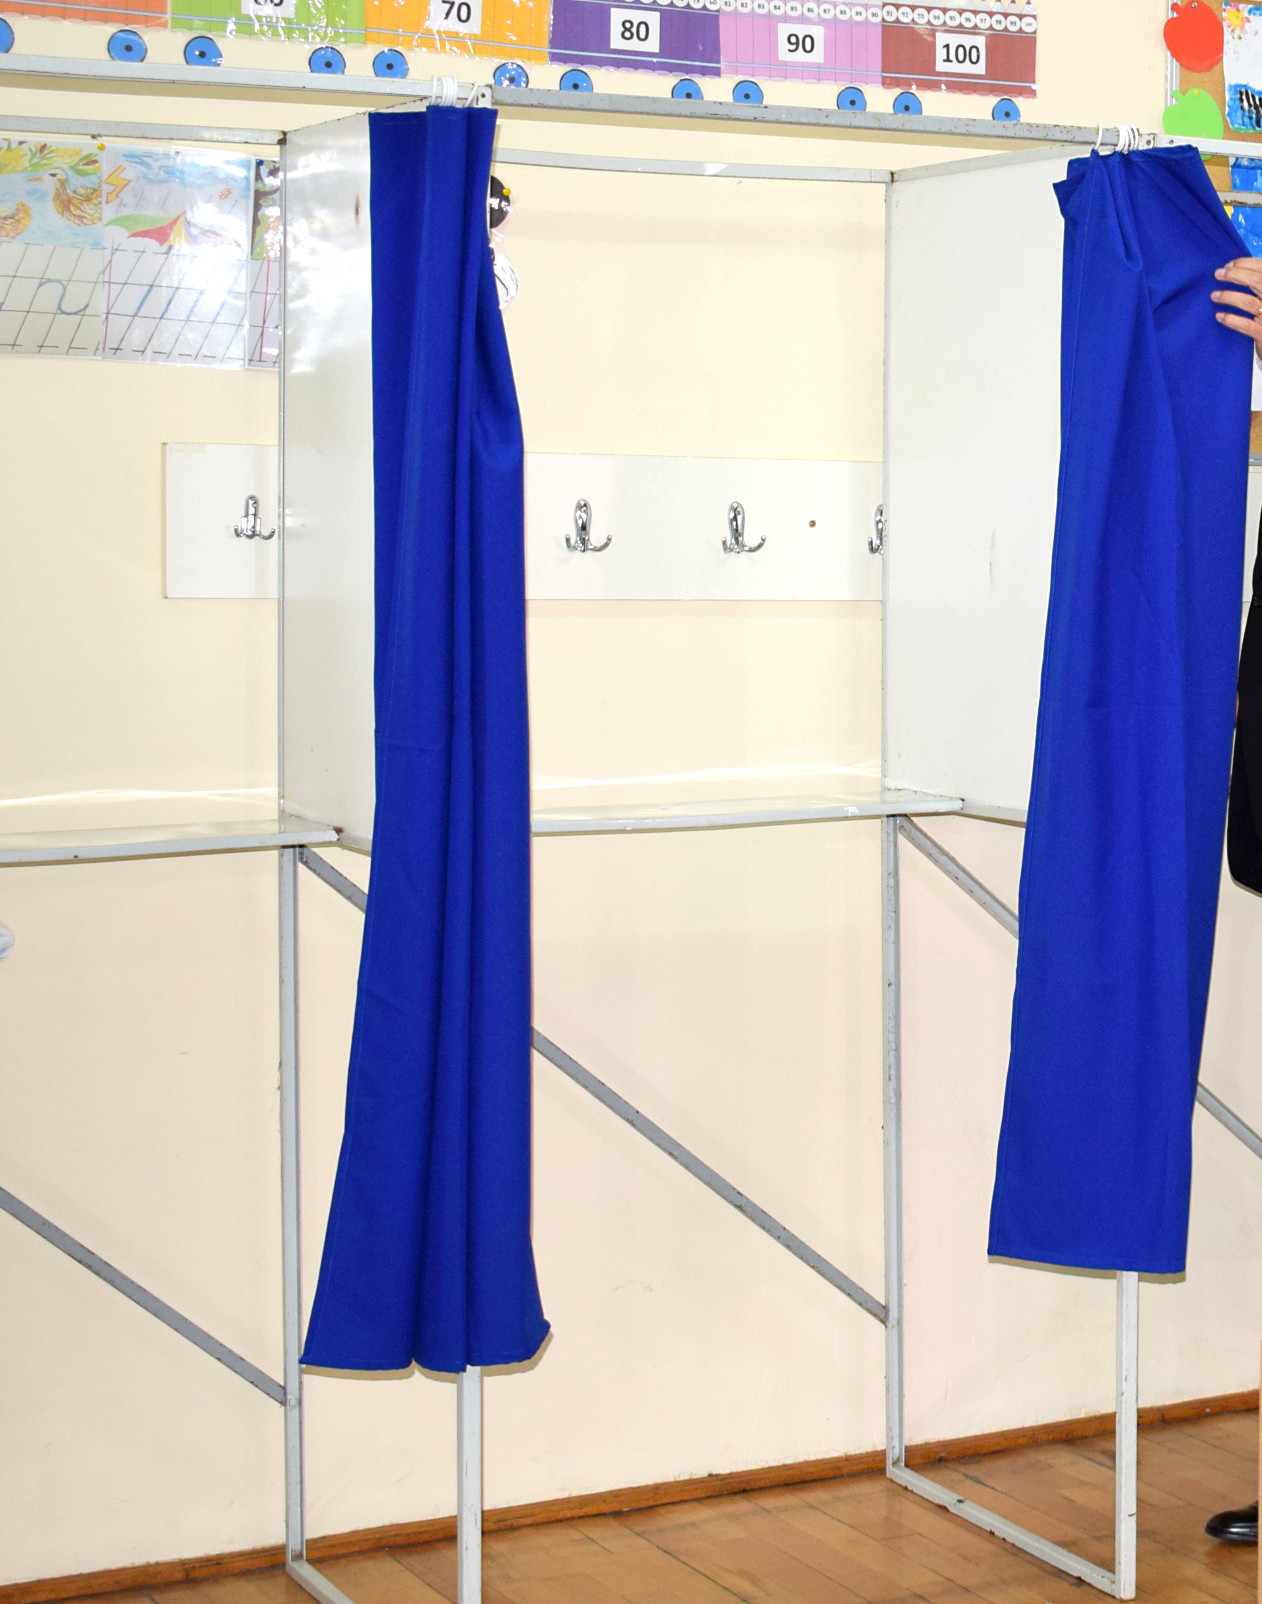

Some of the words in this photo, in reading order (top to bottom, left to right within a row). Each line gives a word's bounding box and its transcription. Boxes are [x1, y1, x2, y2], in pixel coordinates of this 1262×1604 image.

[442, 0, 471, 23] 70
[620, 19, 650, 42] 80
[787, 33, 815, 54] 90
[942, 43, 981, 65] 100
